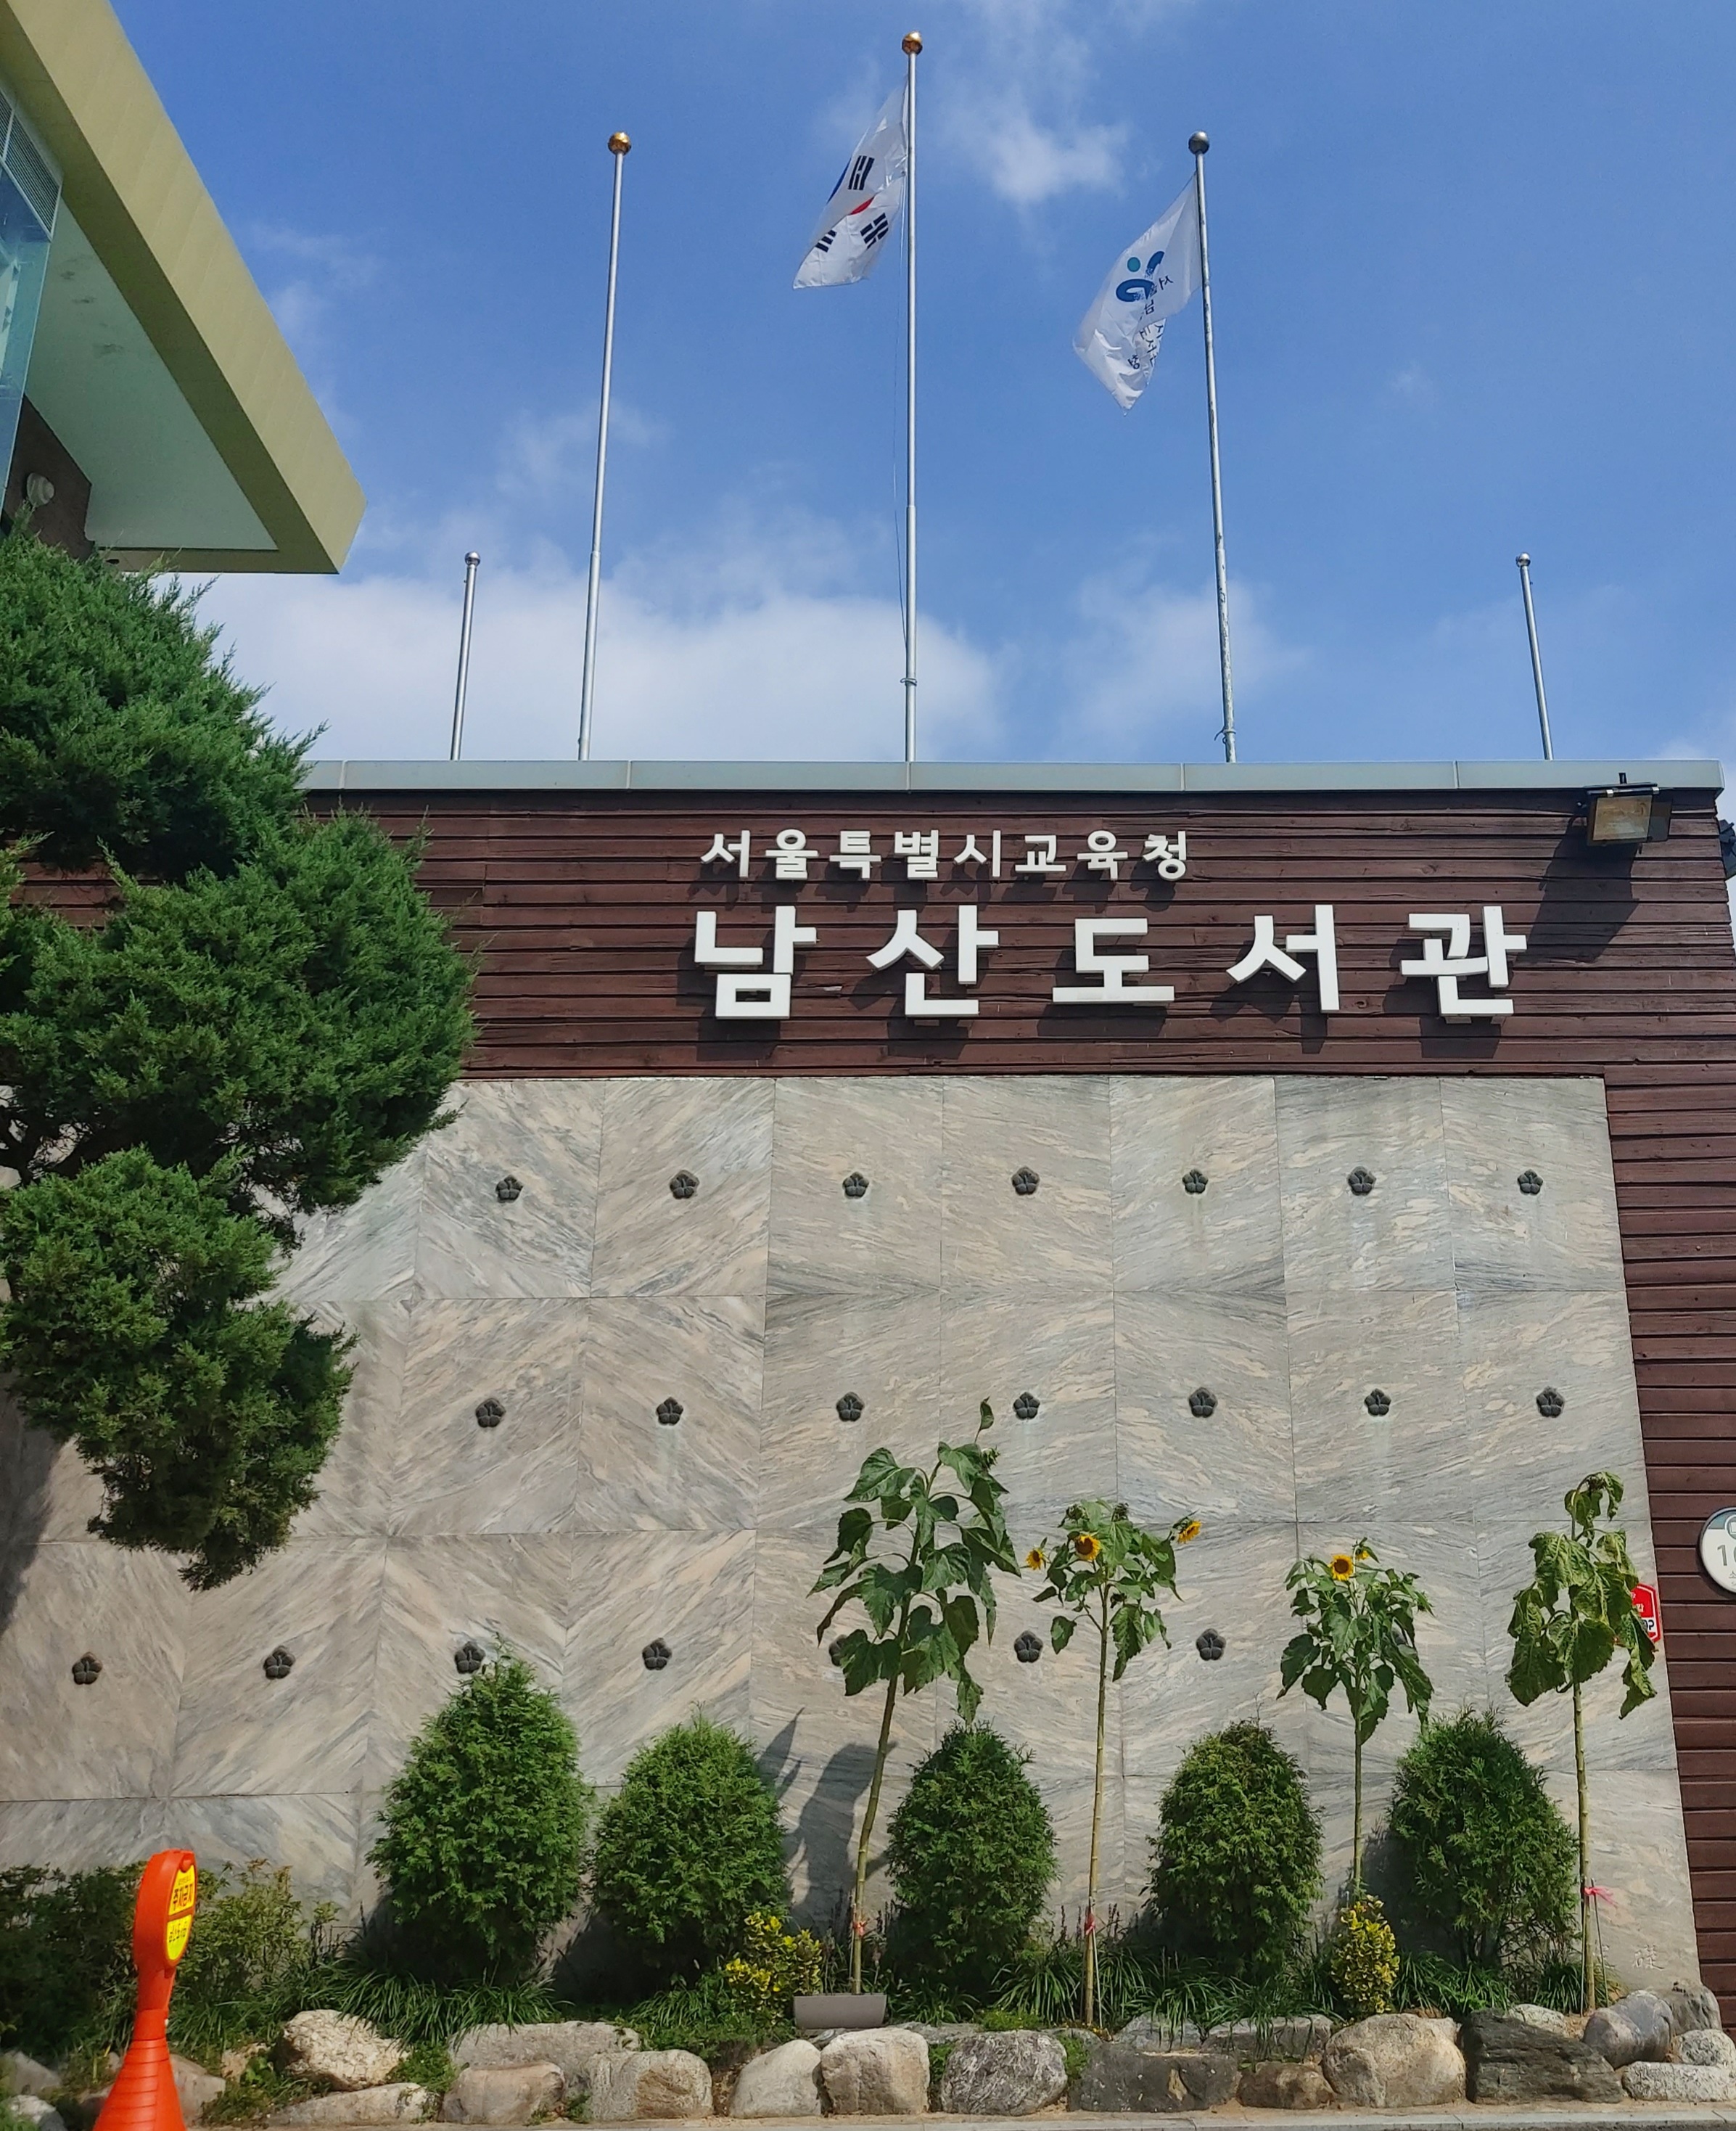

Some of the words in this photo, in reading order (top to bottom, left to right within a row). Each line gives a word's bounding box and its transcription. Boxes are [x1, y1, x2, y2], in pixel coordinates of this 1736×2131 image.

[700, 829, 1188, 881] 서울특별시교육청
[694, 904, 1528, 1020] 남산도서관
[173, 1883, 194, 1911] 주차금지
